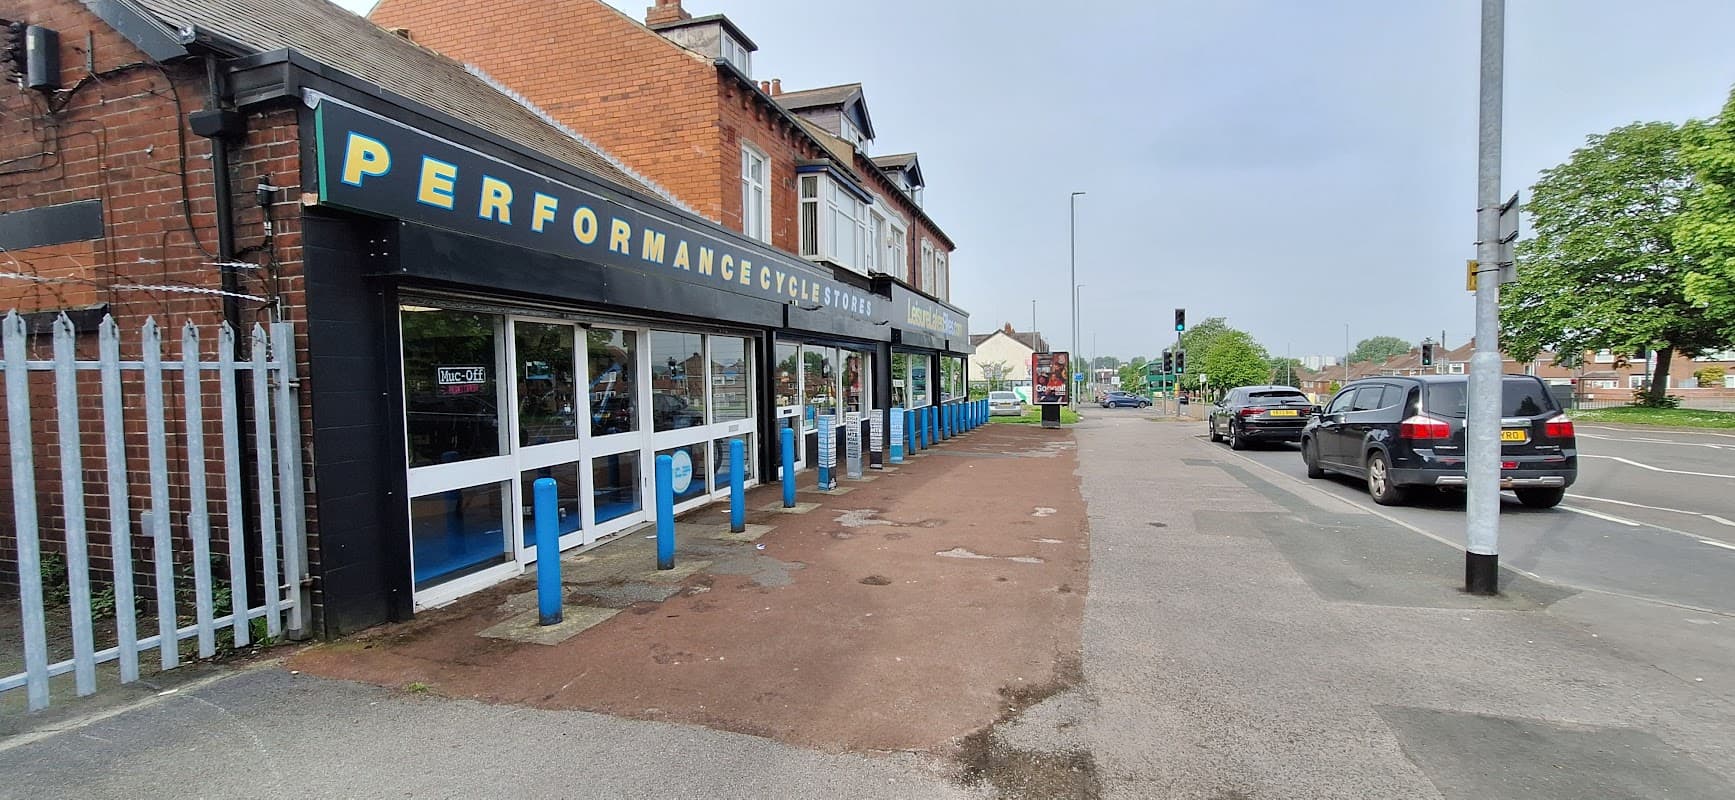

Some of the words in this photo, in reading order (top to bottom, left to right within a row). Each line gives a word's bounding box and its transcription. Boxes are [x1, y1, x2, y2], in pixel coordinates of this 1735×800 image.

[340, 130, 752, 286] PERFORMANCE
[759, 266, 820, 303] CYCLE
[824, 287, 872, 317] STORES
[440, 370, 483, 382] Muc-Off
